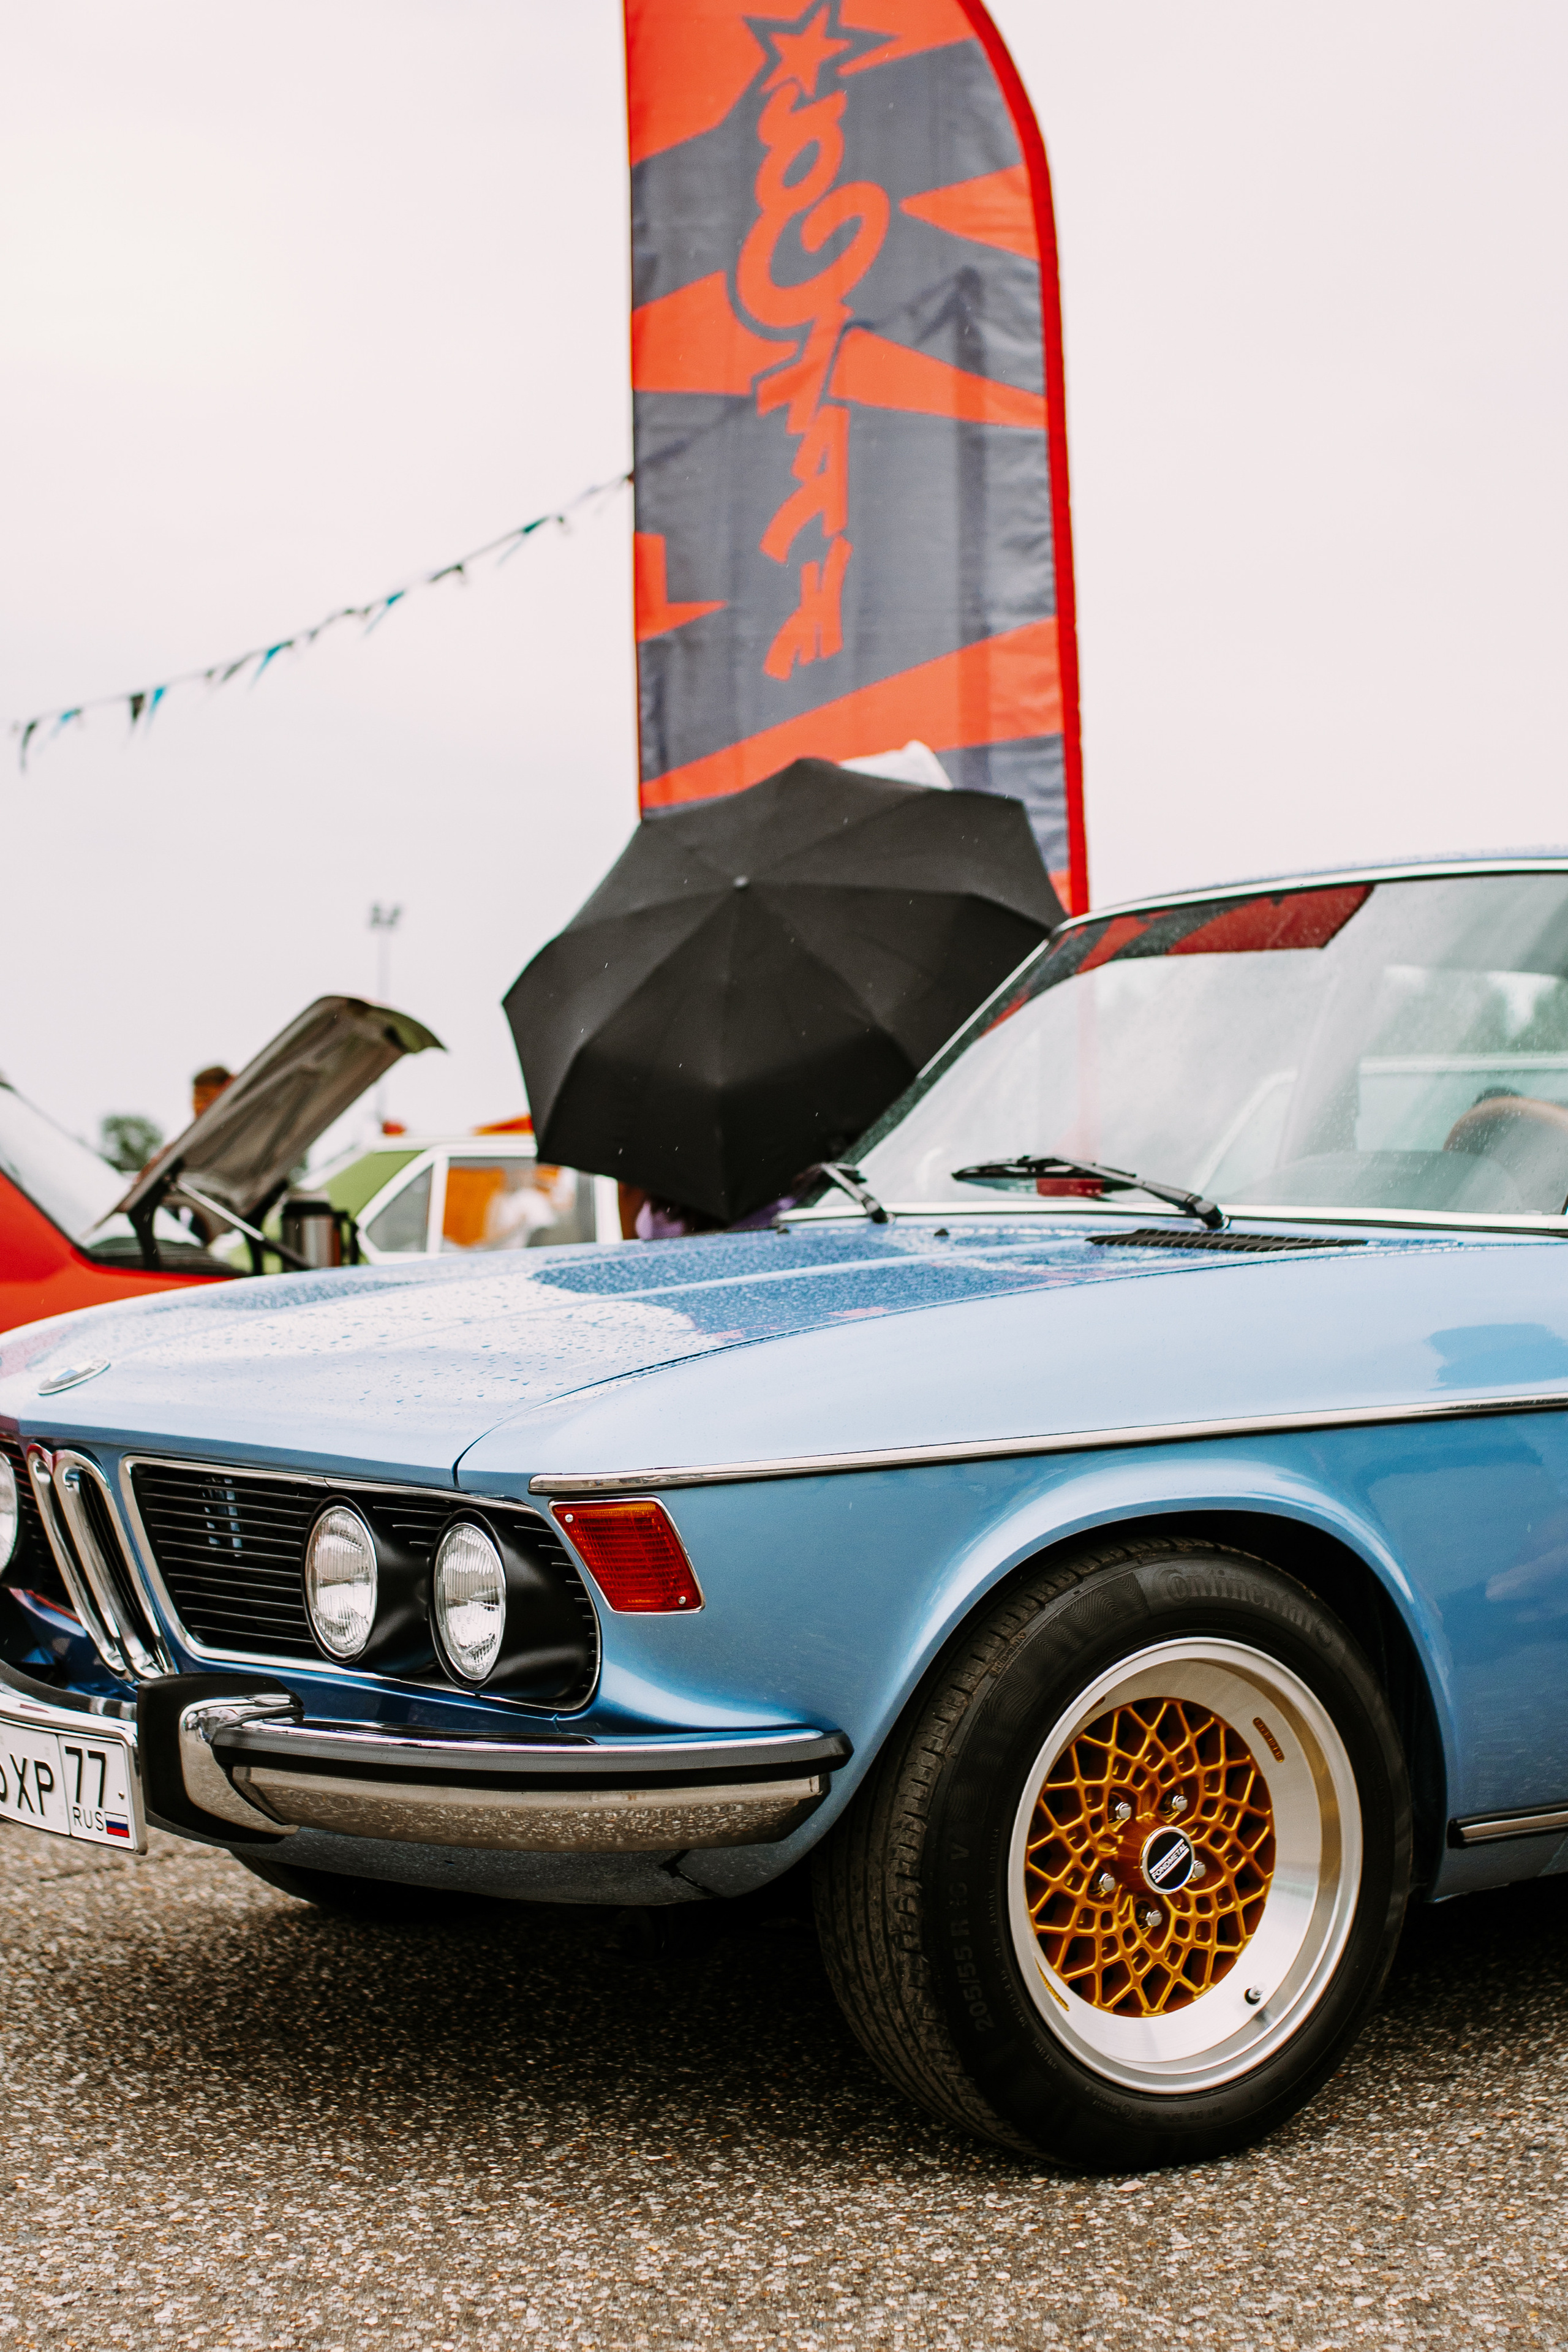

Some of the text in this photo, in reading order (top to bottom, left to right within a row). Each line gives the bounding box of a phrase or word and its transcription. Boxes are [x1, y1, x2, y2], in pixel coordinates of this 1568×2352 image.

[65, 1746, 106, 1808] 77
[72, 1806, 104, 1831] RUS
[1151, 1843, 1189, 1880] FONDMETAL
